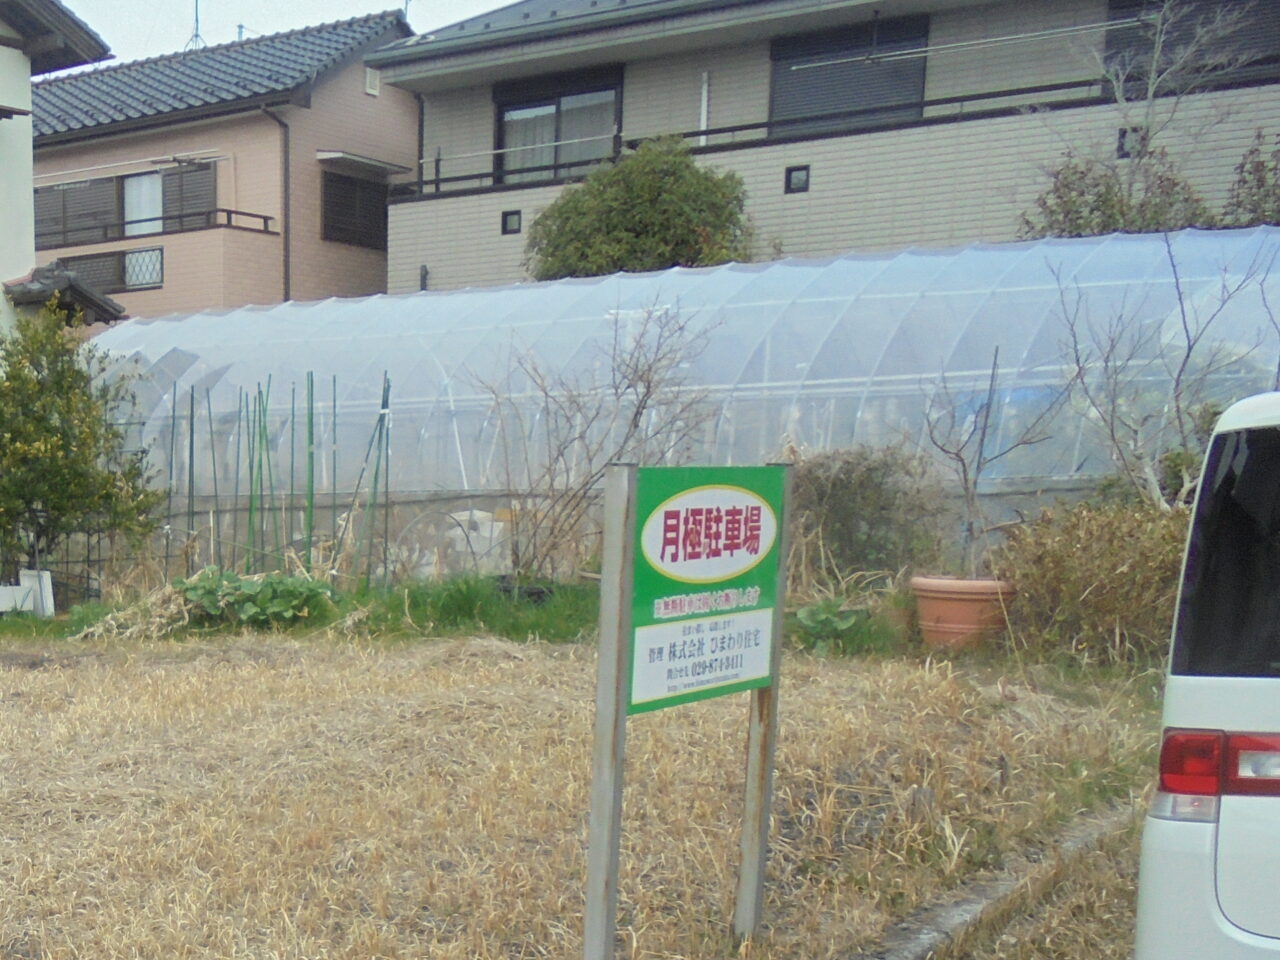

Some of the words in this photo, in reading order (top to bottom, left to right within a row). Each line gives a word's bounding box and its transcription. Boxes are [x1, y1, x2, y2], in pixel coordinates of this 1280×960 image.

[660, 505, 761, 562] 月極駐車場
[649, 647, 664, 663] 管理
[669, 637, 705, 662] 株式会社
[711, 629, 761, 653] ひまわり住宅
